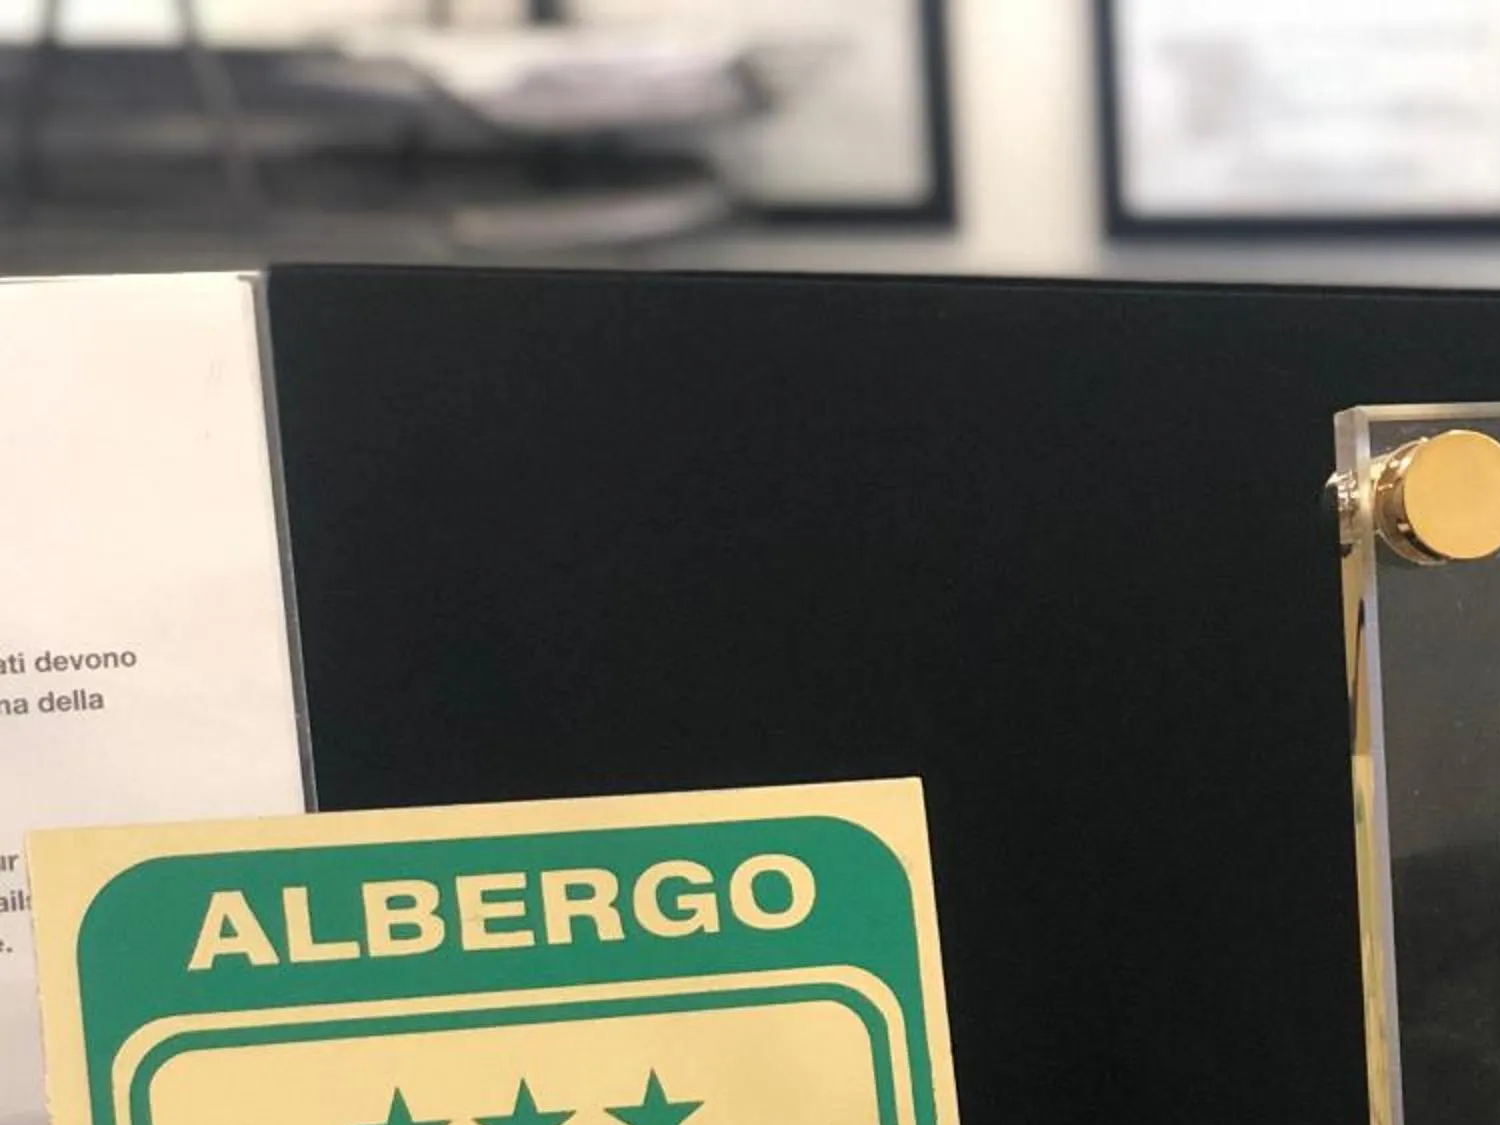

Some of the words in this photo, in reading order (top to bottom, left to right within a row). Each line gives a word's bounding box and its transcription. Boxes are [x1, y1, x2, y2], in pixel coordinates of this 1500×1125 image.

[35, 649, 137, 673] devono
[38, 689, 104, 714] della
[187, 853, 817, 972] ALBERGO
